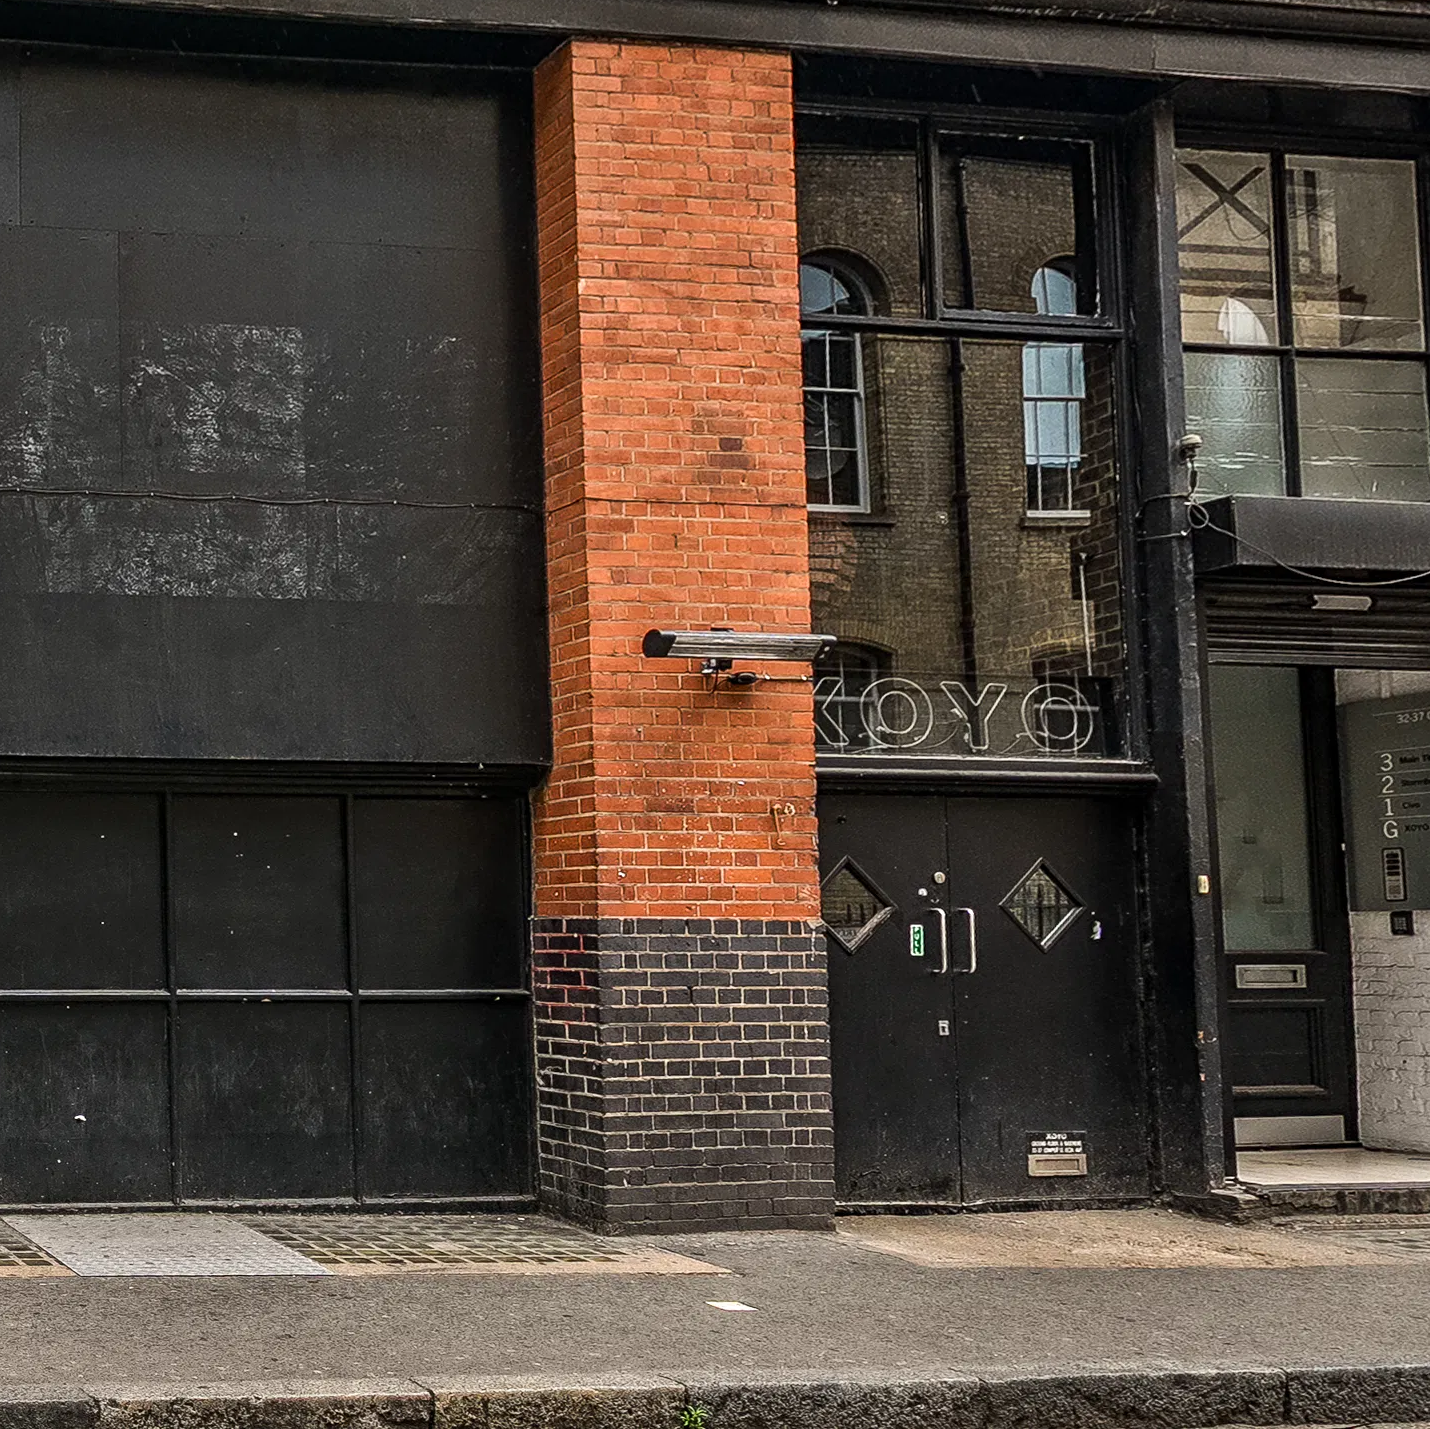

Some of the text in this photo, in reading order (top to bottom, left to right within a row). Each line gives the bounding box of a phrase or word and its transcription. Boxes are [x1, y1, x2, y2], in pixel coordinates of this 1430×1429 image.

[1380, 753, 1394, 772] 3
[1381, 775, 1395, 794] 2
[1384, 798, 1395, 816] 1
[1383, 820, 1399, 839] G
